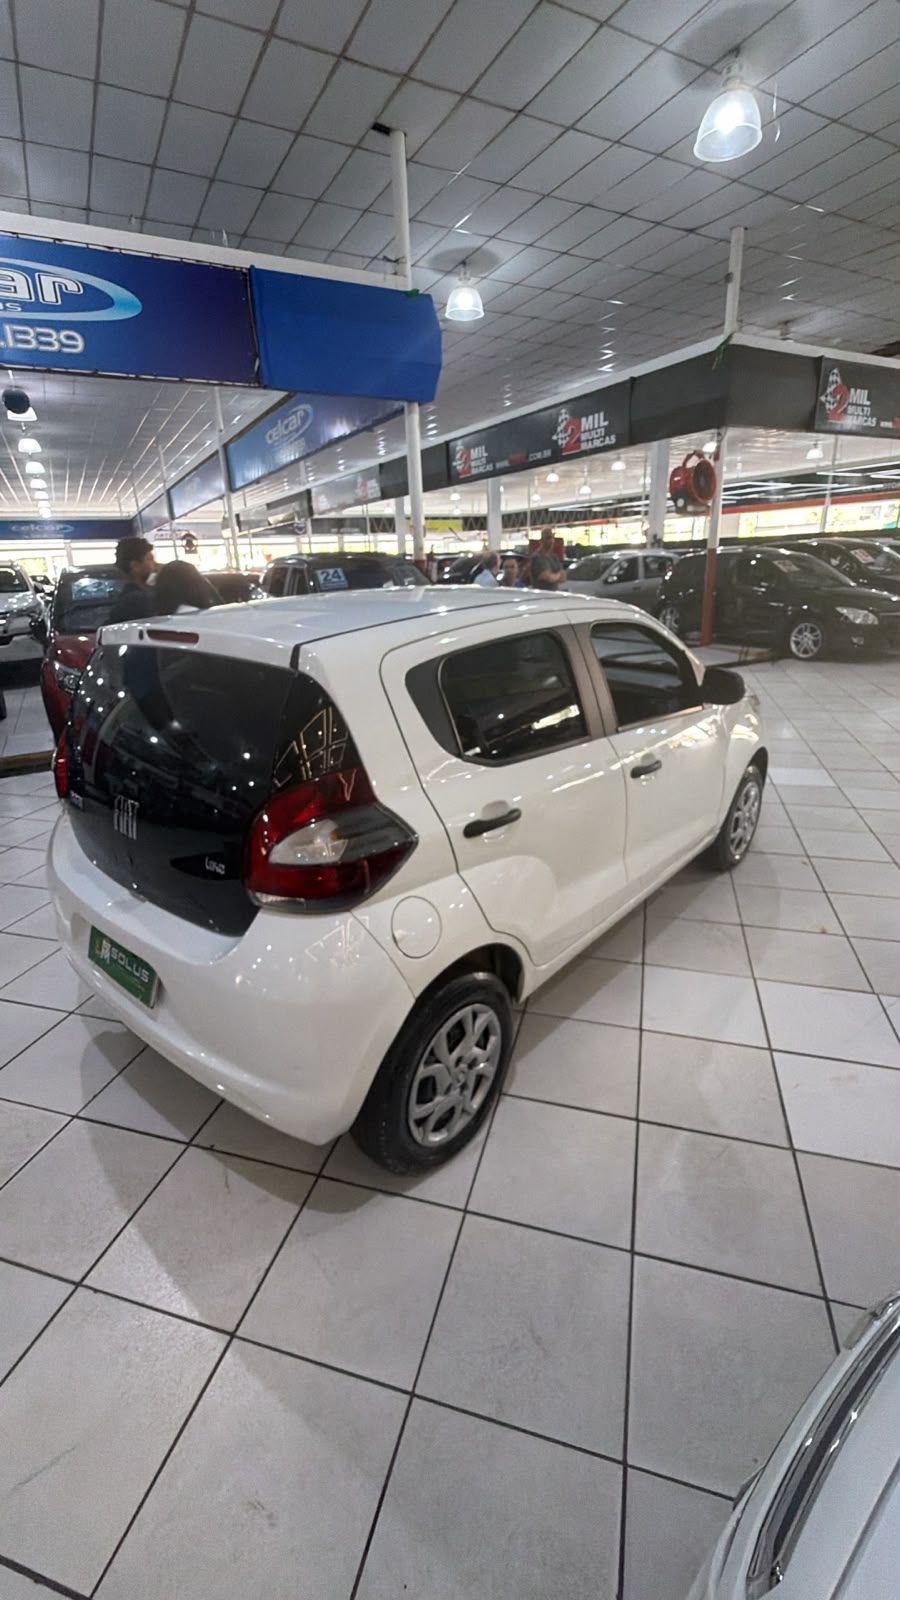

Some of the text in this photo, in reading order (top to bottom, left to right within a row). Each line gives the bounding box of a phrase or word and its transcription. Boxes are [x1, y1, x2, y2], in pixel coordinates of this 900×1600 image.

[849, 388, 871, 406] MIL
[848, 405, 871, 416] MULTI
[266, 410, 305, 444] celcar
[580, 411, 609, 432] MIL
[848, 415, 877, 427] MARCAS
[580, 428, 605, 442] MULTI
[581, 434, 617, 450] MARCAS
[470, 445, 488, 460] MIL
[320, 570, 342, 581] 24
[110, 947, 150, 983] SOLUS
